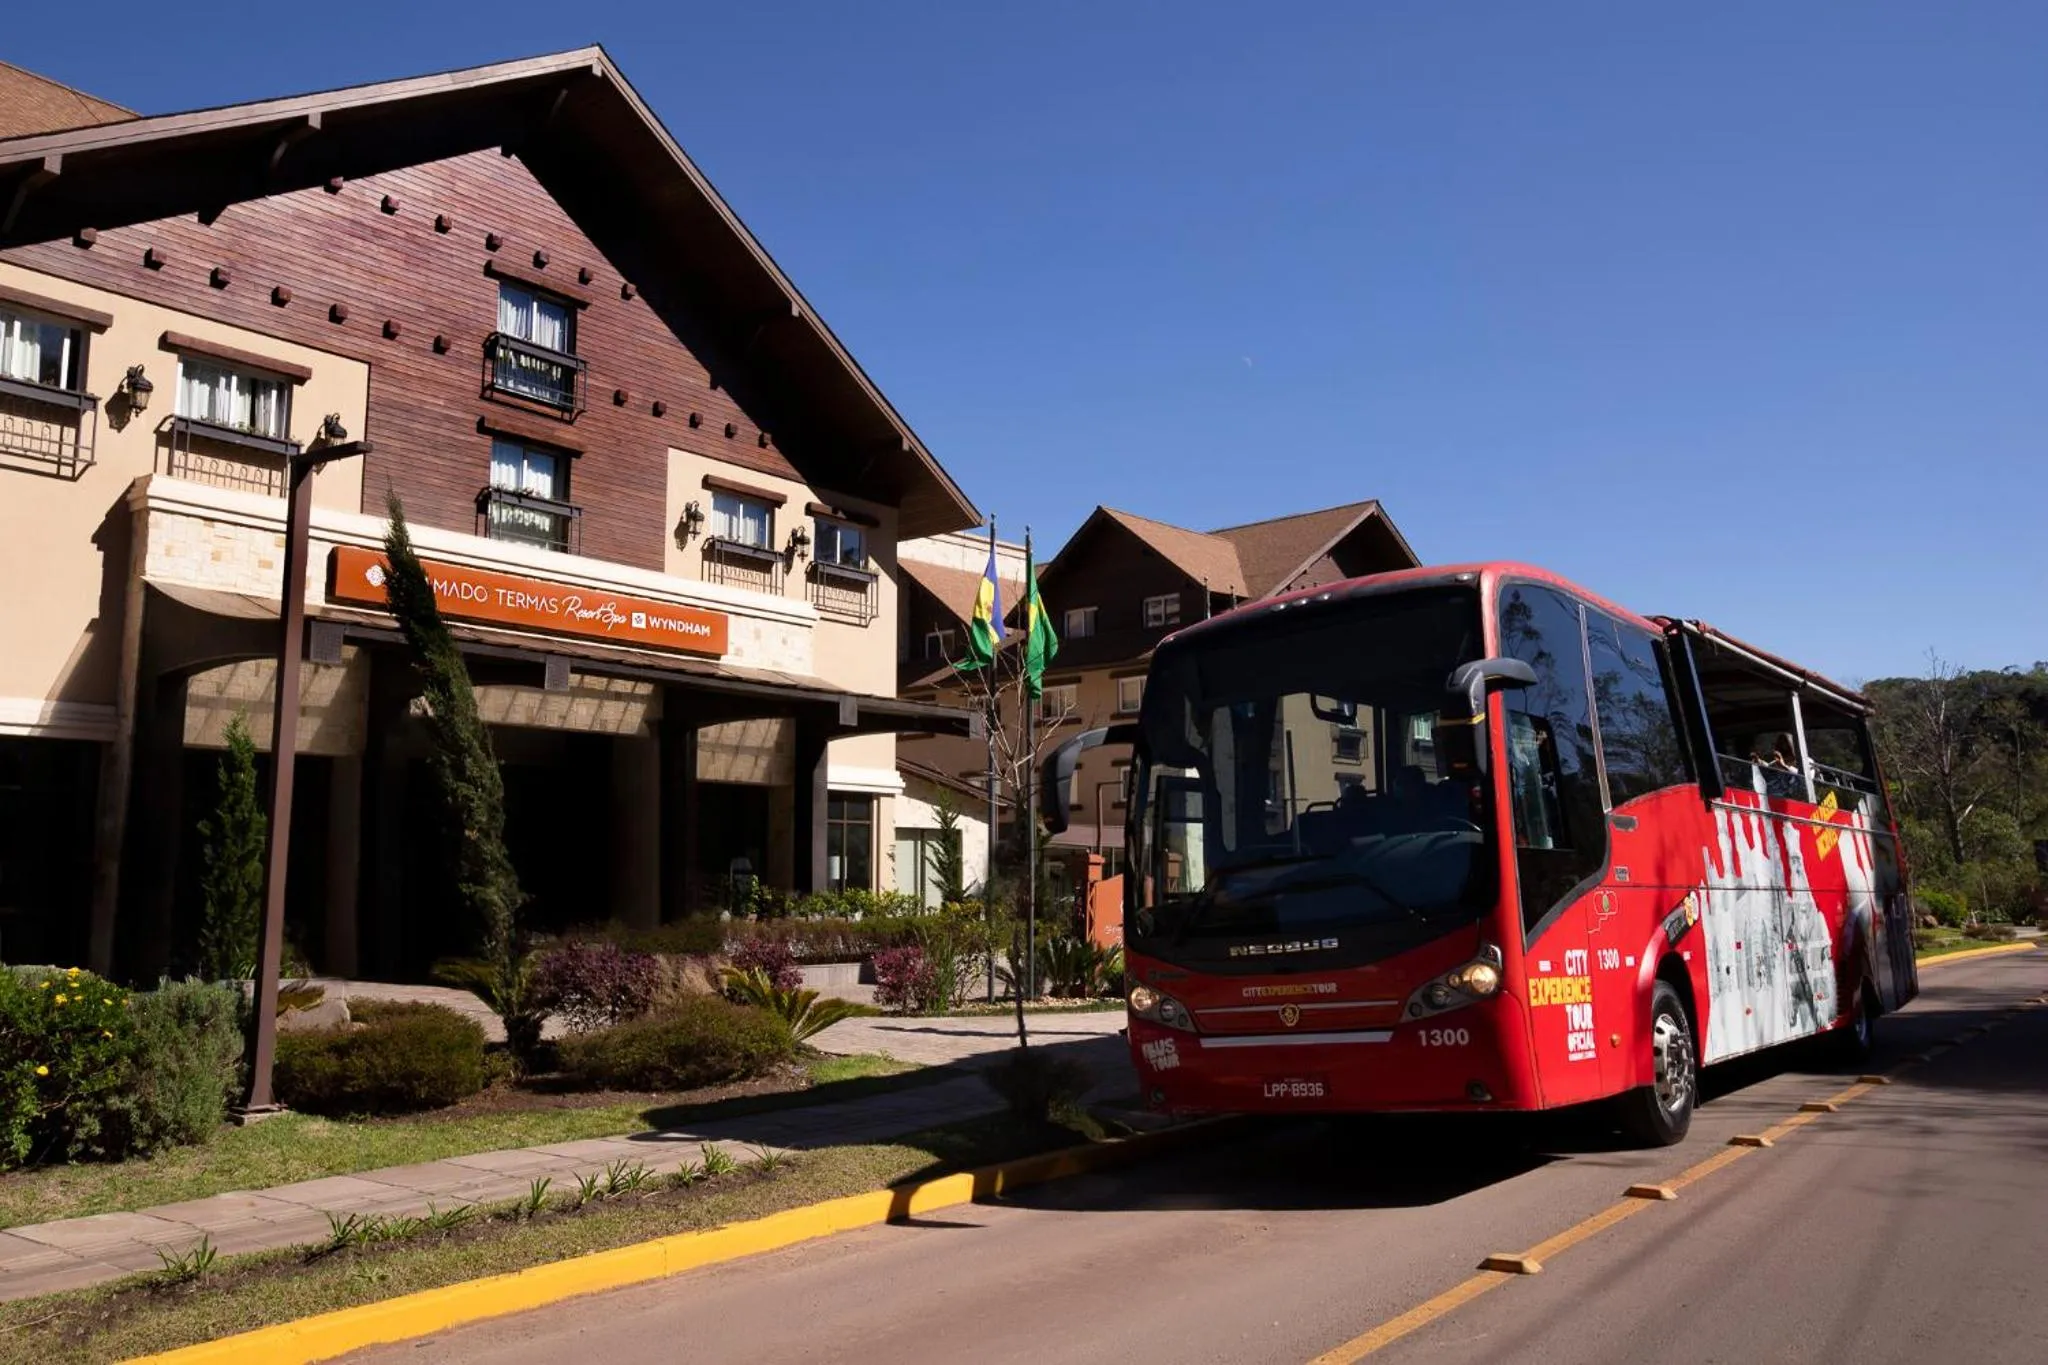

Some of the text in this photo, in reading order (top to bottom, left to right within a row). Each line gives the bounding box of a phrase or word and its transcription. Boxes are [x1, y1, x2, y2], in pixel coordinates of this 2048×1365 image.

[425, 577, 488, 603] MADO
[495, 588, 559, 613] TERMAS
[649, 615, 711, 637] WYNDHAM
[1564, 949, 1588, 976] CITY
[1597, 948, 1620, 970] 1300
[1528, 975, 1593, 1007] EXPERIENCE
[1565, 1003, 1595, 1031] TOUR
[1418, 1028, 1470, 1047] 1300
